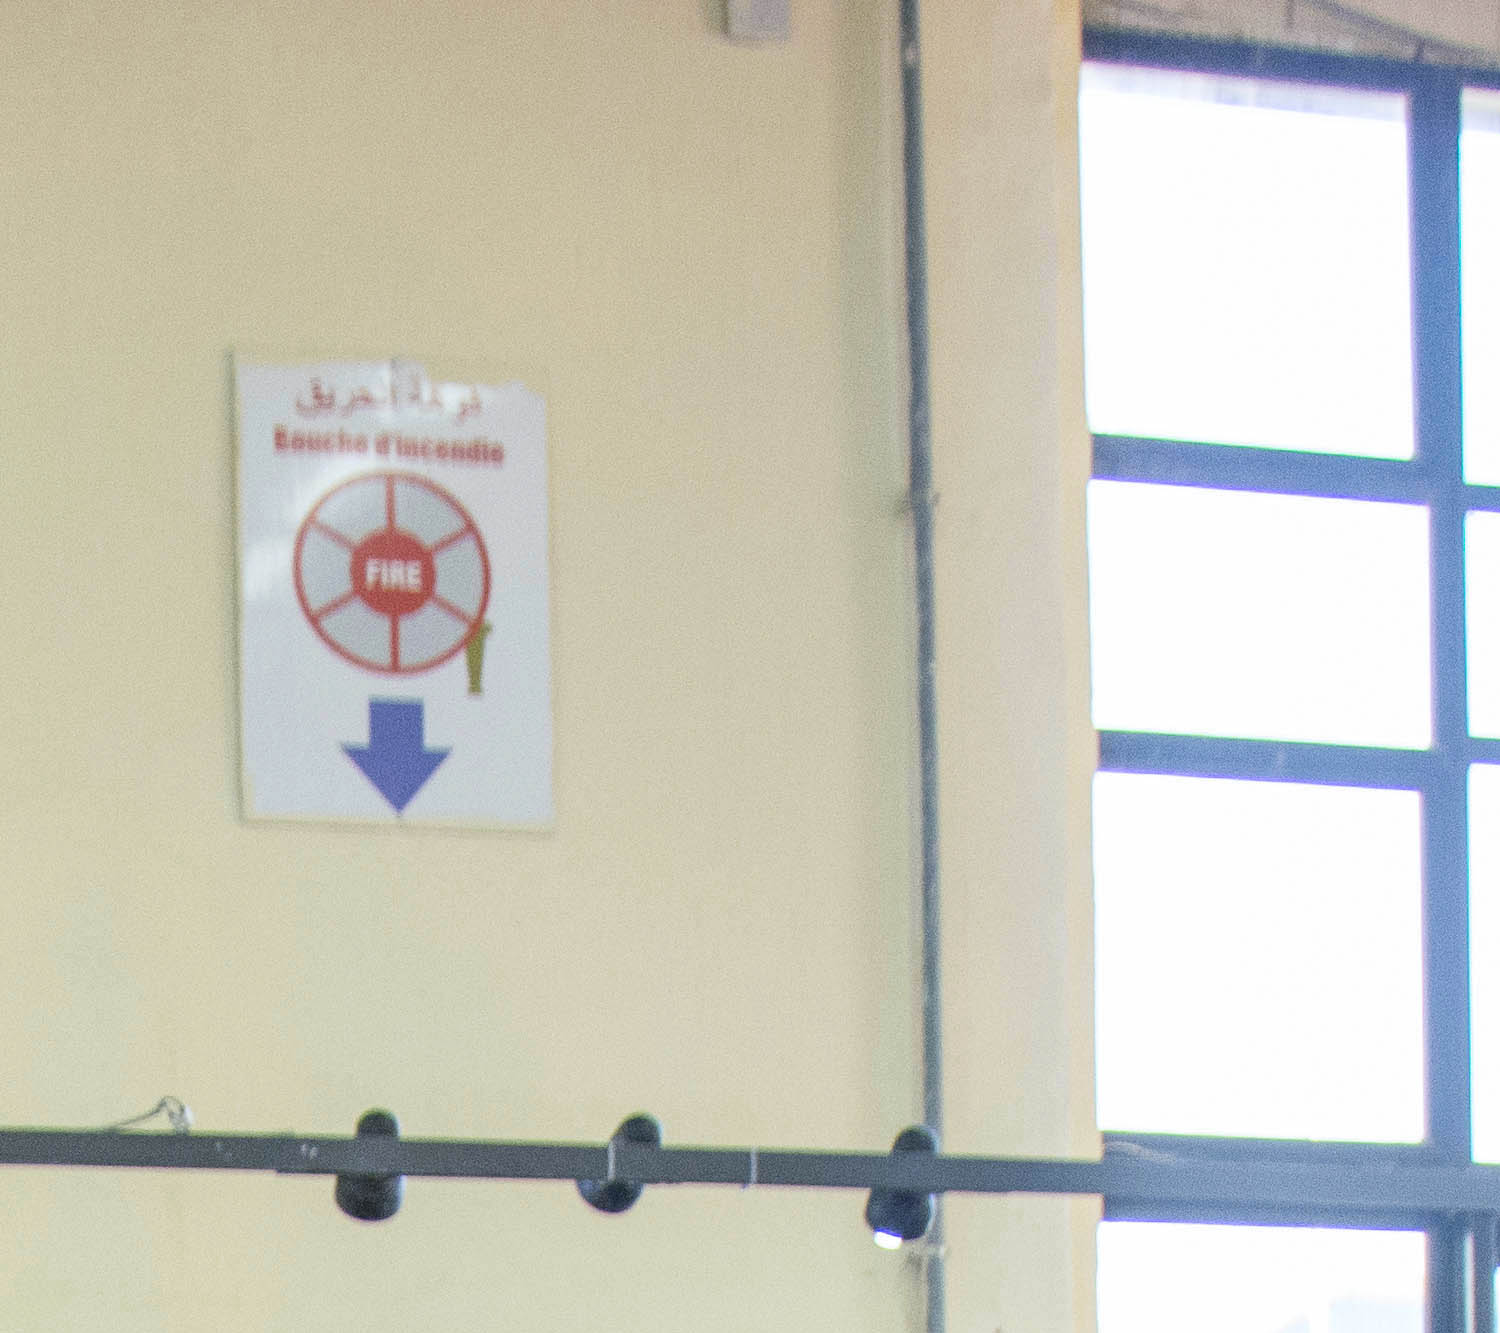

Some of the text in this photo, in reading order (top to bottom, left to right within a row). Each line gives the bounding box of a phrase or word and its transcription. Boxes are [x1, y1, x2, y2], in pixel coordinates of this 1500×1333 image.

[273, 422, 505, 467] Bouche d'incendie
[366, 557, 422, 593] FIRE
